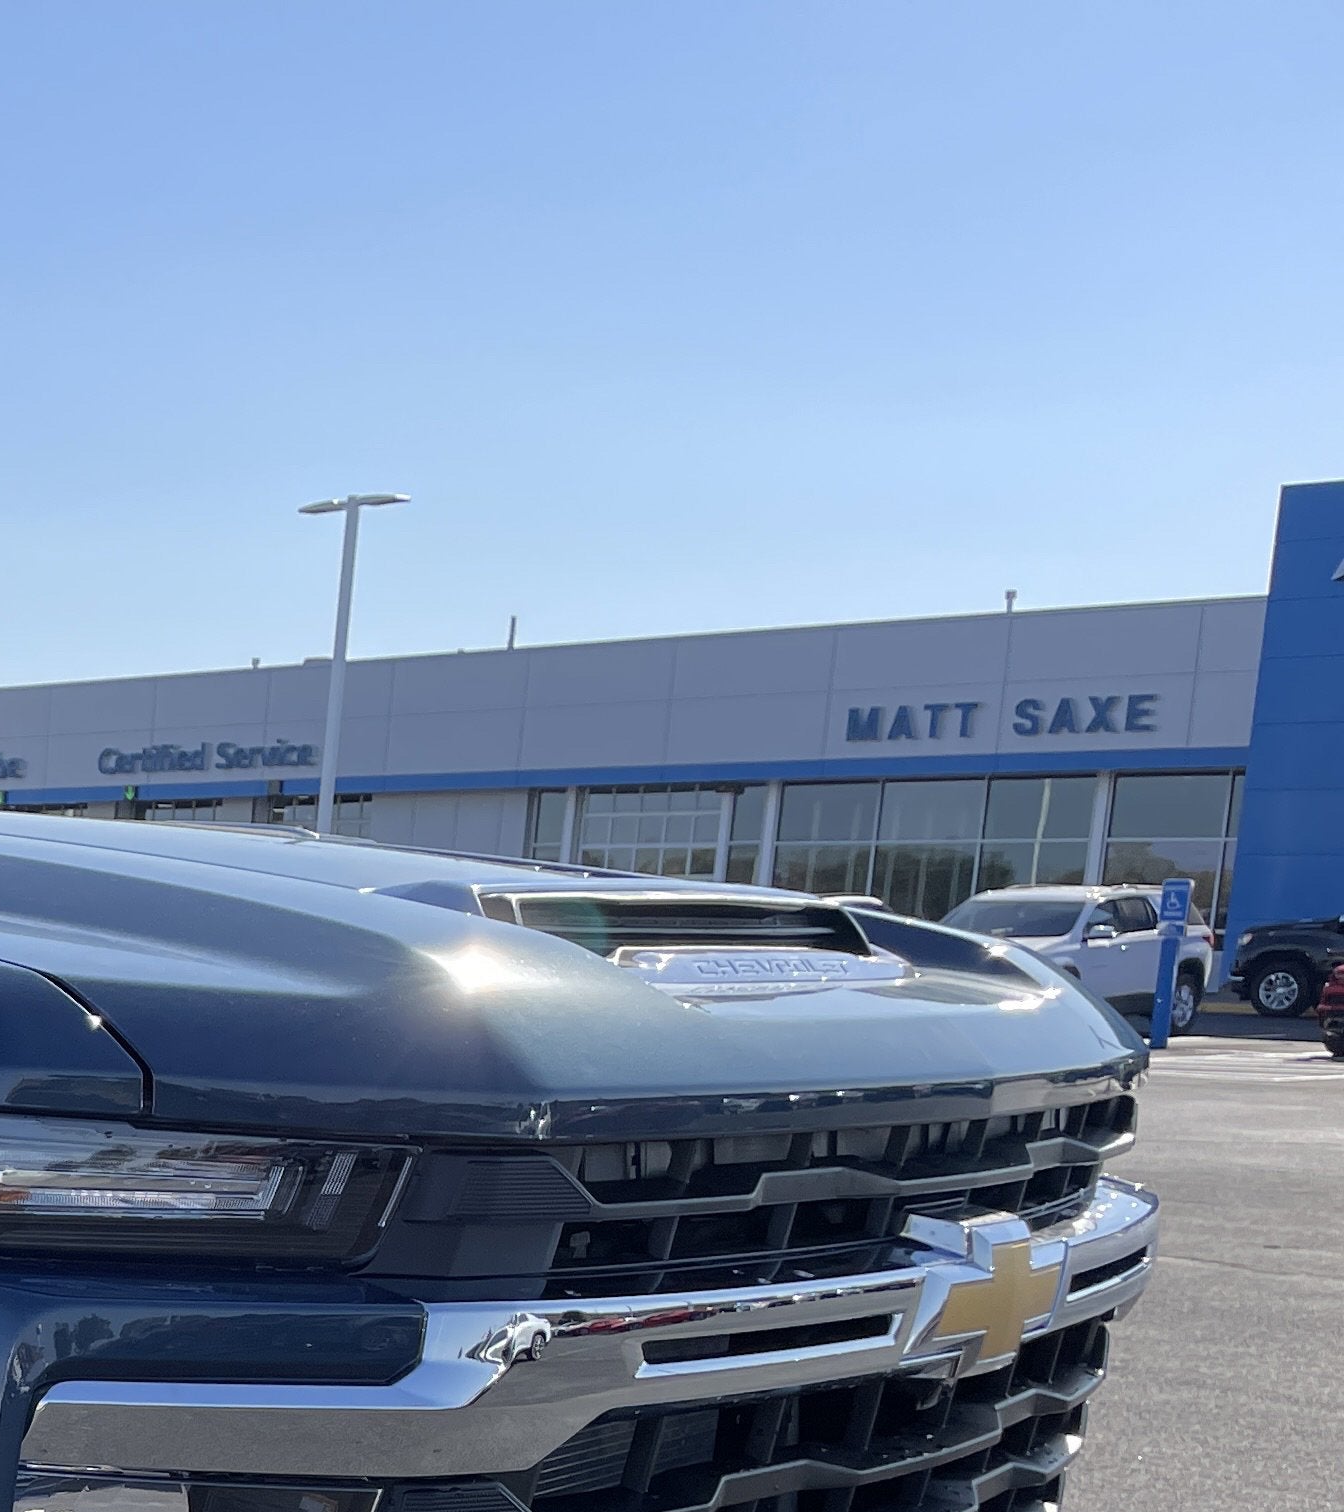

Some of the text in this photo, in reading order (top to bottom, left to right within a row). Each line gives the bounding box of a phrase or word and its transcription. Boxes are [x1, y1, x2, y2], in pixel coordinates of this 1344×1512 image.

[845, 693, 1160, 742] MATT SAXE
[98, 738, 322, 775] Certified Service
[692, 957, 850, 977] CHEVROLET
